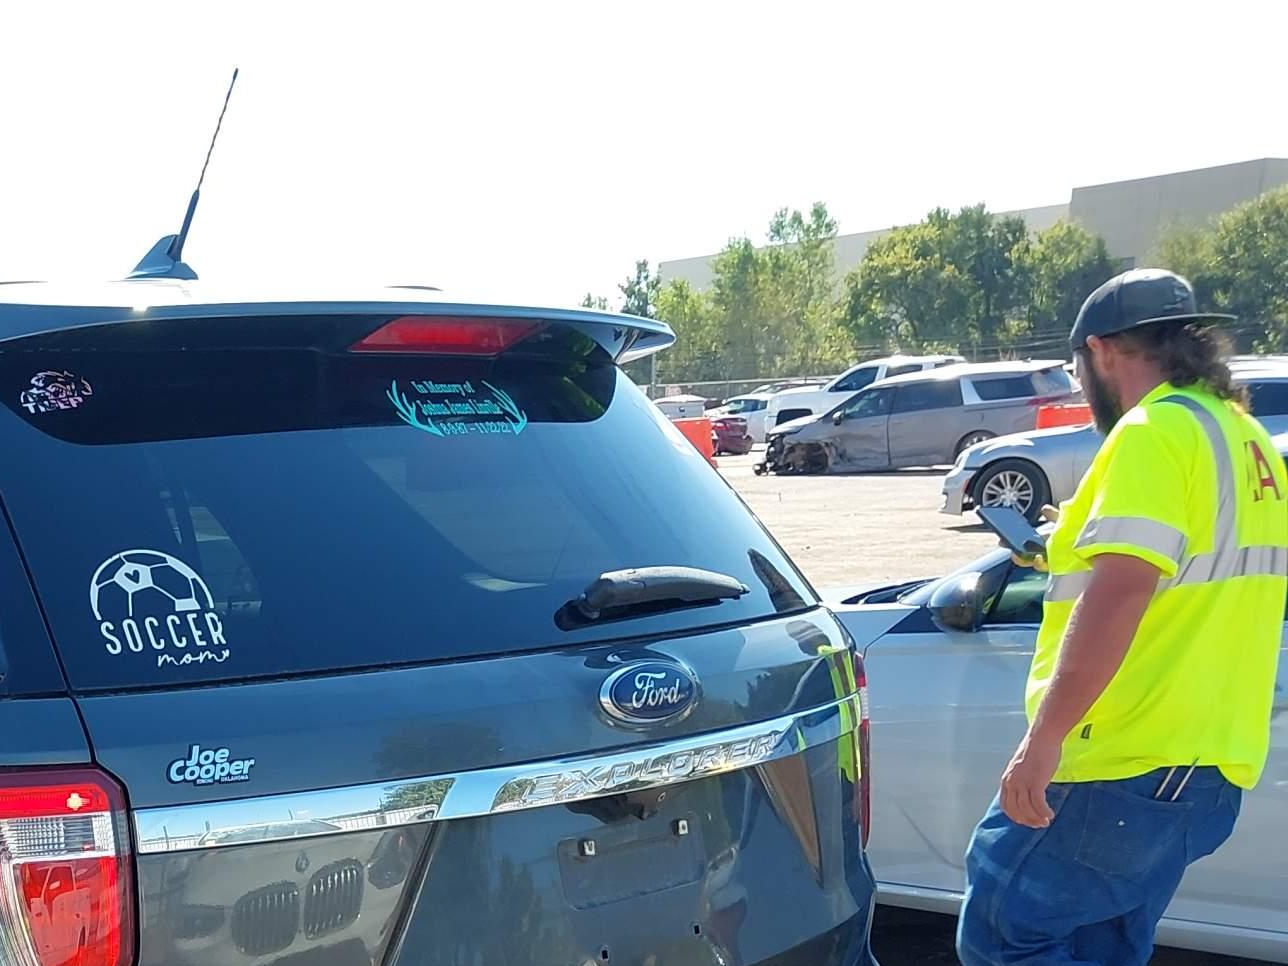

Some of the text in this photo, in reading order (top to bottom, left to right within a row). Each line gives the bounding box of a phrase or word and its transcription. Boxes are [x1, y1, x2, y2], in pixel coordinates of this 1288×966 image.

[100, 612, 226, 655] SOCCER
[157, 649, 230, 667] mom
[632, 672, 680, 708] Ford
[170, 759, 255, 781] Cooper
[186, 745, 230, 766] Joe
[523, 735, 778, 800] EXPLORER
